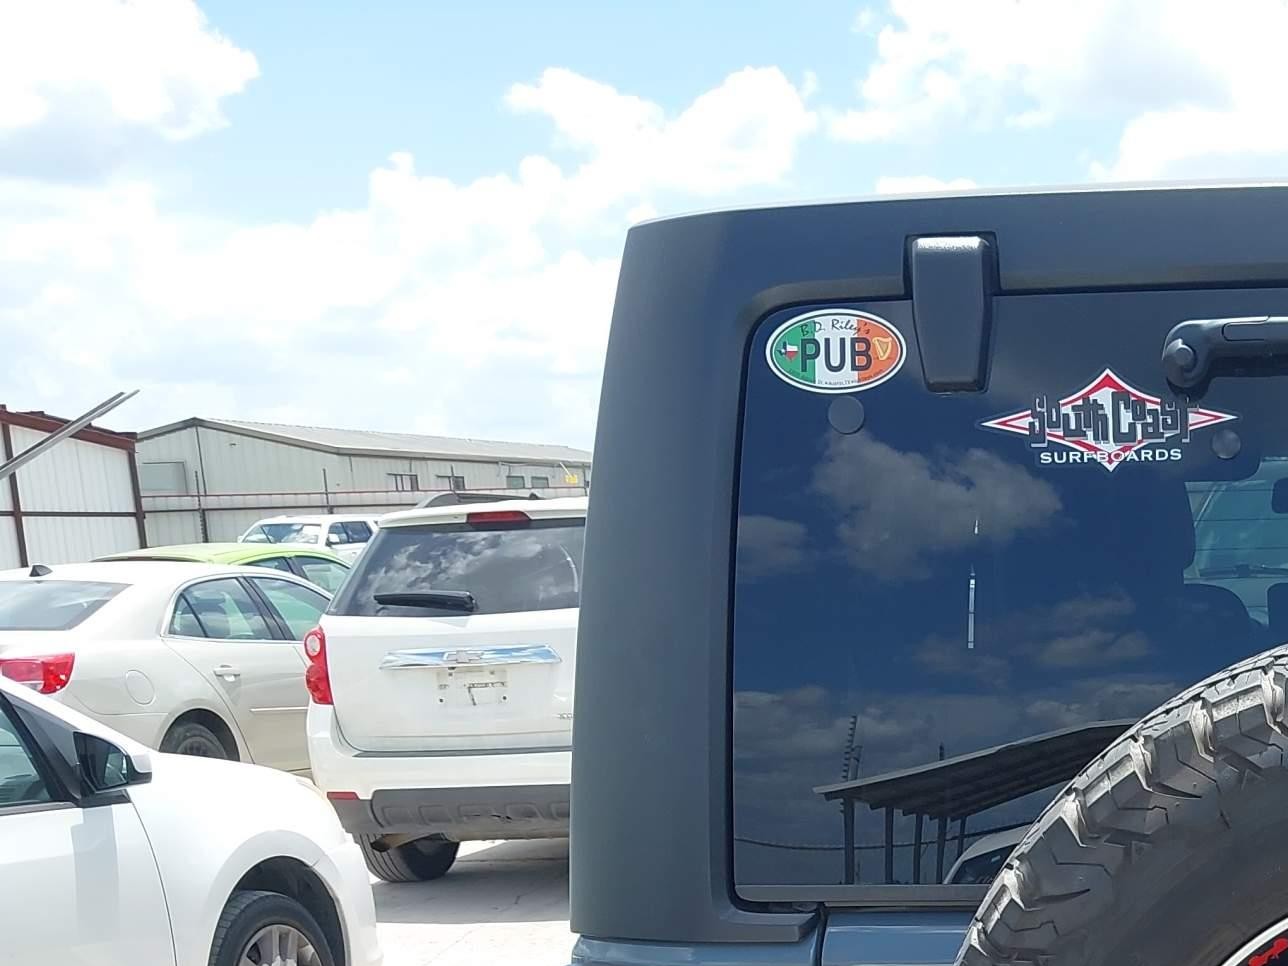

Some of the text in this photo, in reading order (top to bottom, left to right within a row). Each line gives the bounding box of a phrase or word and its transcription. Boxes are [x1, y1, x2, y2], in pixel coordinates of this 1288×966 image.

[831, 318, 871, 336] Riley's
[800, 337, 873, 373] PUB
[1040, 448, 1182, 464] SURFBOARDS
